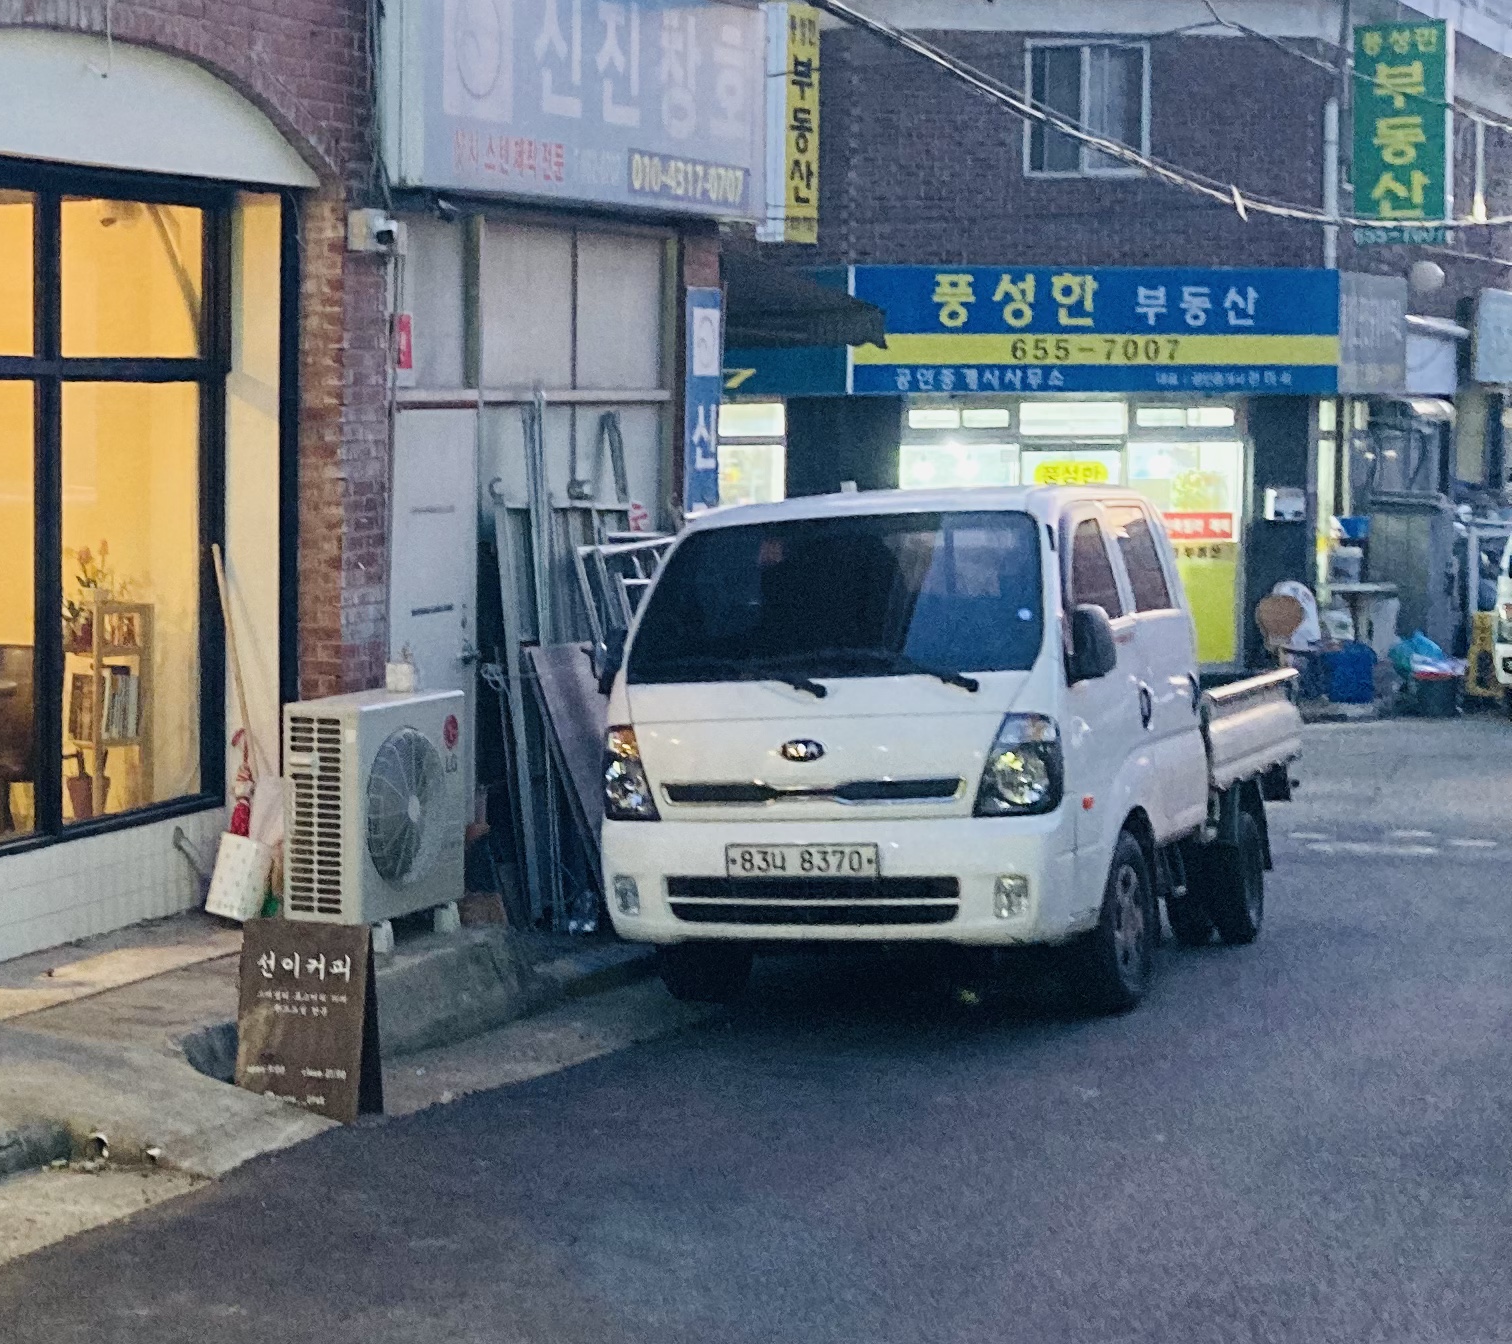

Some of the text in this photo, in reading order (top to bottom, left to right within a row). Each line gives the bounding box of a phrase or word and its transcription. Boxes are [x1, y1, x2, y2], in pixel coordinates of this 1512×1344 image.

[790, 55, 814, 205] 부동산
[1371, 60, 1431, 219] 부동산
[932, 273, 1259, 328] 풍성한 부동산
[1011, 338, 1181, 362] 655-7007
[800, 850, 863, 873] 8370
[257, 950, 352, 984] 선이커피
